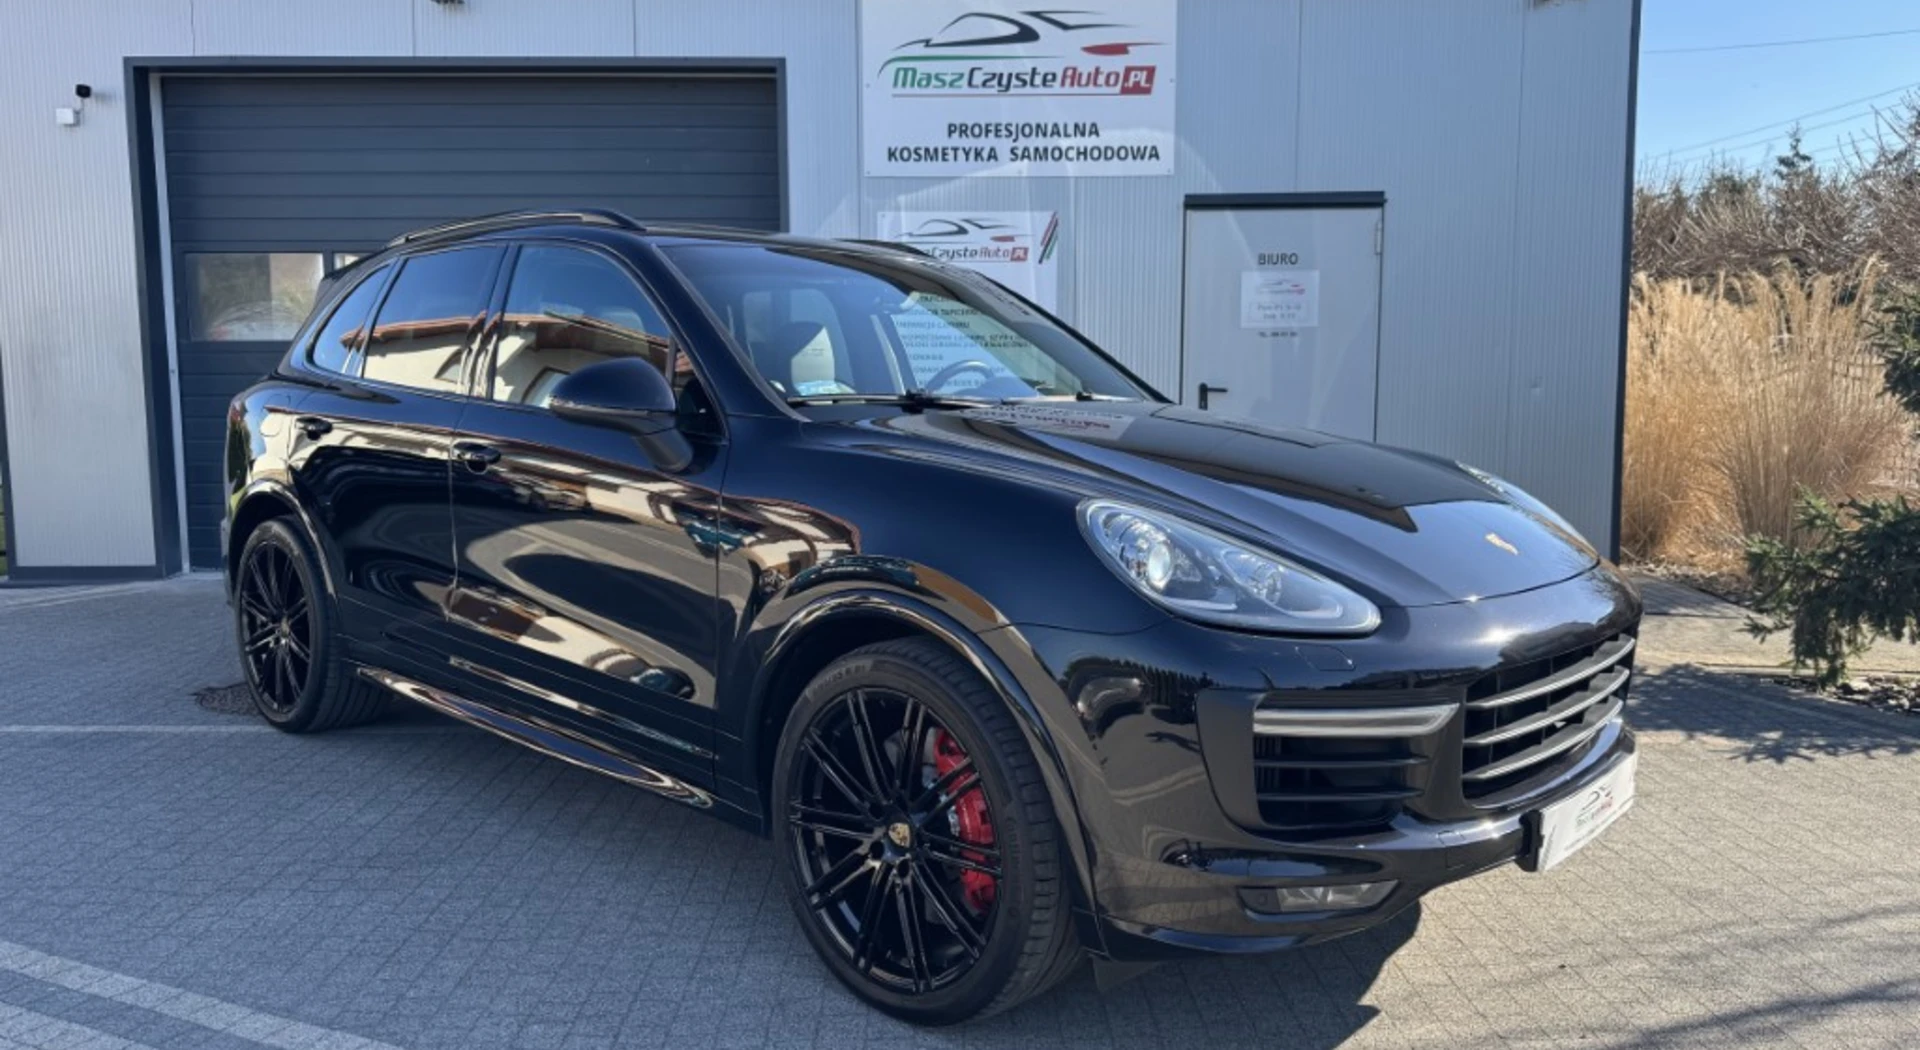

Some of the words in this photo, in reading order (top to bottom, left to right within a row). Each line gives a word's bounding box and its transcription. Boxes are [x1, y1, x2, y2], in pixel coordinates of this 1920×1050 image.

[947, 122, 1101, 142] PROFESJONALNA
[887, 146, 999, 163] KOSMETYKA
[1009, 145, 1161, 162] SAMOCHODOWA
[1258, 252, 1299, 266] BIURO
